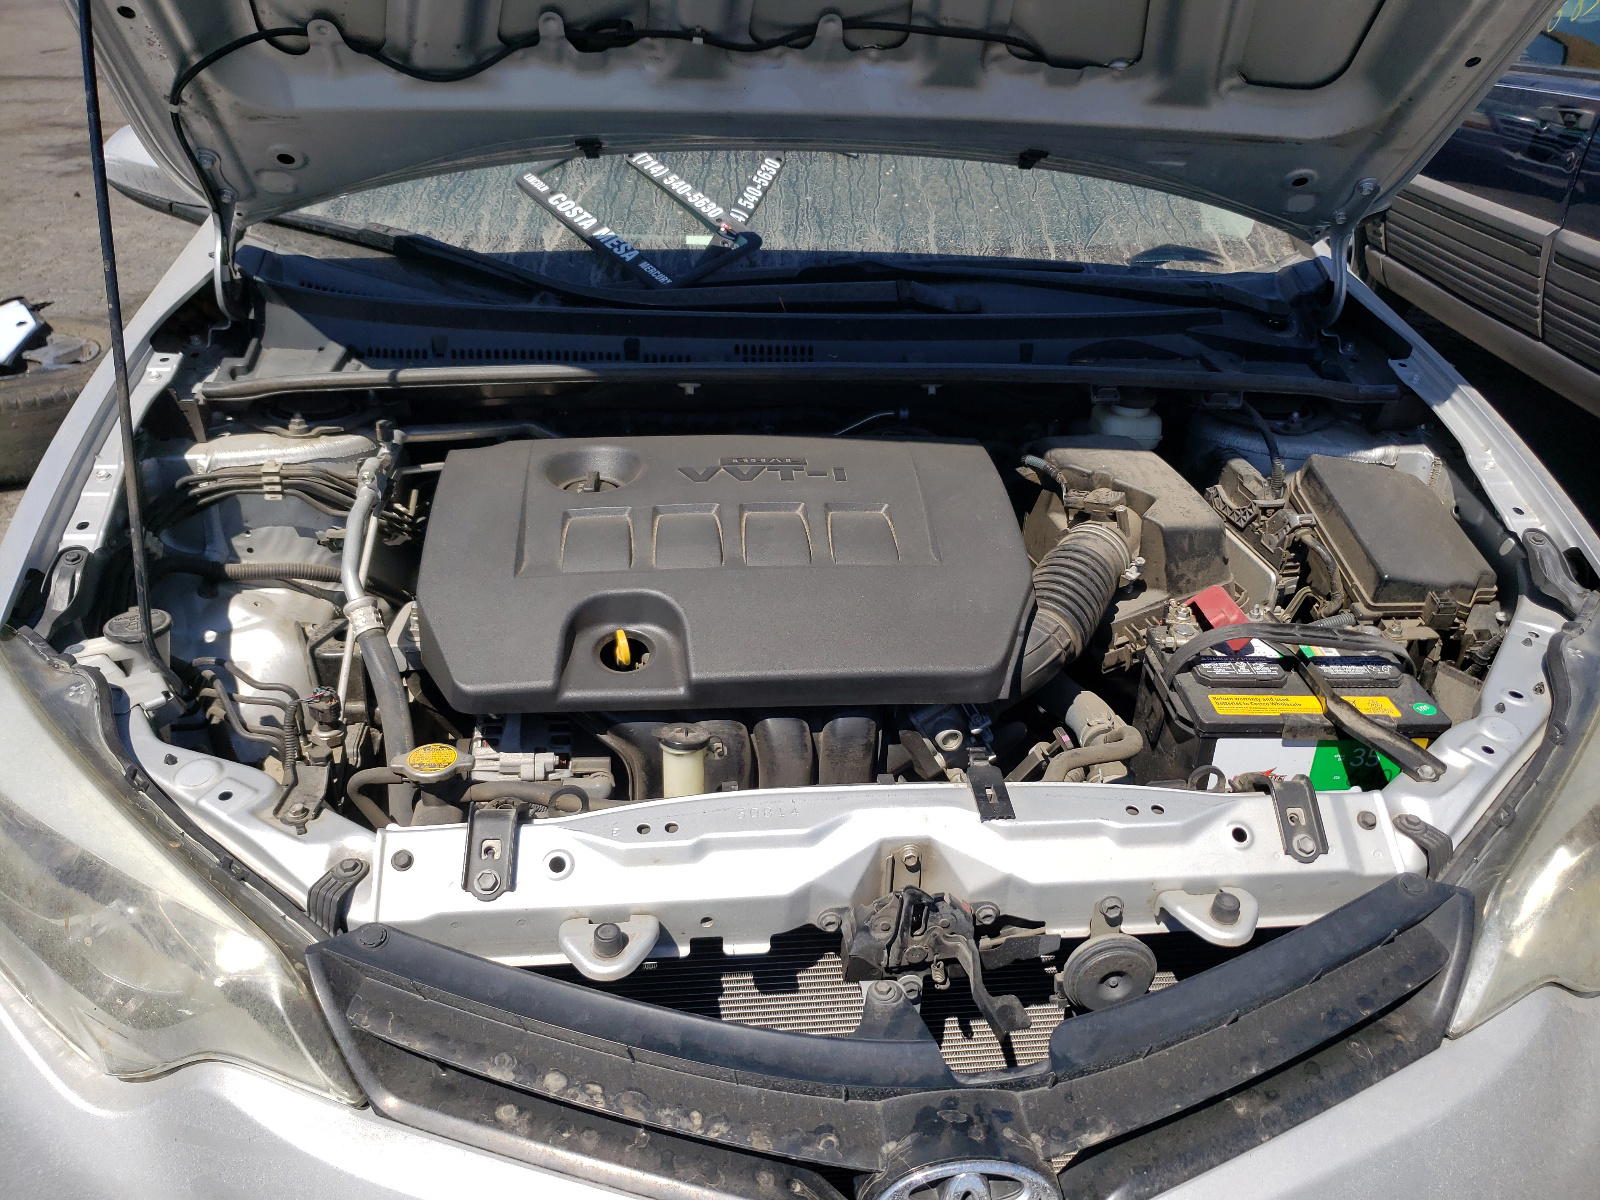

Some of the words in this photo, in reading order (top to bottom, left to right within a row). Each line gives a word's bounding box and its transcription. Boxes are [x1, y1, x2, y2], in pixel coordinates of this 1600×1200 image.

[632, 151, 670, 178] (714)
[663, 174, 724, 219] 540-5630
[737, 157, 781, 210] 540-5630
[548, 193, 598, 230] COSTA
[592, 226, 639, 262] MESA
[638, 261, 673, 286] MERCURY
[1350, 748, 1380, 767] 35
